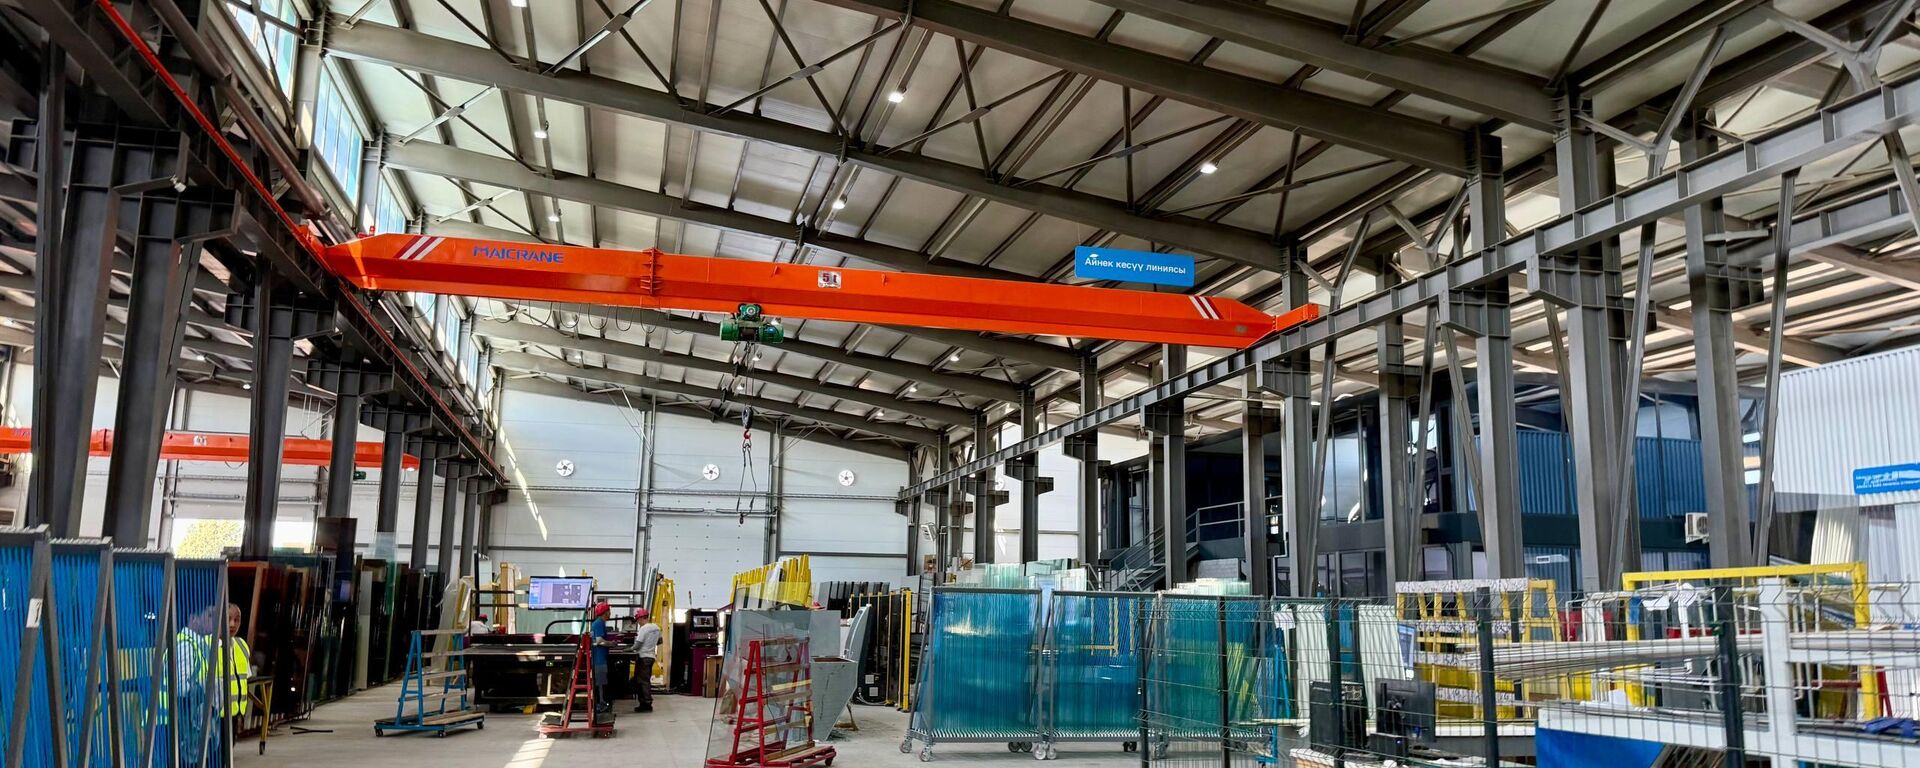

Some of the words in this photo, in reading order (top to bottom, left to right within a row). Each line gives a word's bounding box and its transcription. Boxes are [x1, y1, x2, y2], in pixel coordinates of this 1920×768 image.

[473, 246, 565, 263] MAICRANE
[1084, 257, 1114, 268] Айнек
[1146, 264, 1186, 274] линиясы
